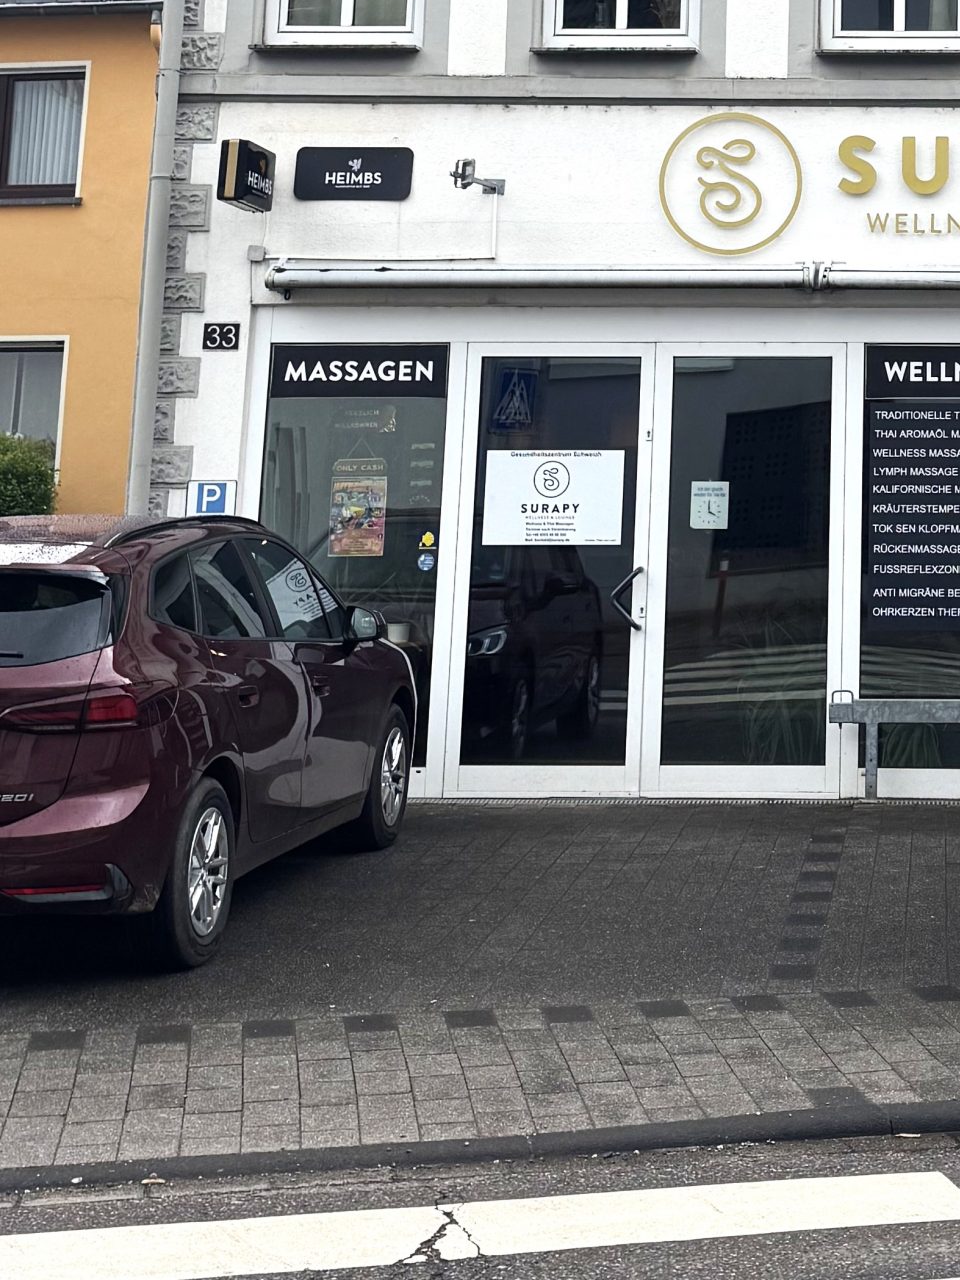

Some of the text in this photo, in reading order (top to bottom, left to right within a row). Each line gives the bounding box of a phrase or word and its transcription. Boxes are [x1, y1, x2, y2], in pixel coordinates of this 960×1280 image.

[247, 170, 272, 195] HEIMBS
[325, 172, 382, 185] HEIMBS
[206, 325, 236, 348] 33
[284, 360, 434, 382] MASSAGEN
[875, 411, 951, 420] TRADITIONELLE
[874, 430, 897, 439] THAI
[899, 428, 948, 439] AROMAÖL
[873, 449, 926, 458] WELLNESS
[336, 464, 358, 472] ONLY
[873, 467, 959, 476] LYMPH MASSAGE
[873, 485, 951, 494] KALIFORNISCHE
[201, 484, 221, 512] P
[521, 503, 580, 513] SURAPY
[872, 524, 893, 533] TOK
[895, 524, 916, 533] SEN
[873, 588, 896, 597] ANTI
[898, 587, 945, 598] MIGRÄNE
[872, 607, 935, 617] OHRKERZEN
